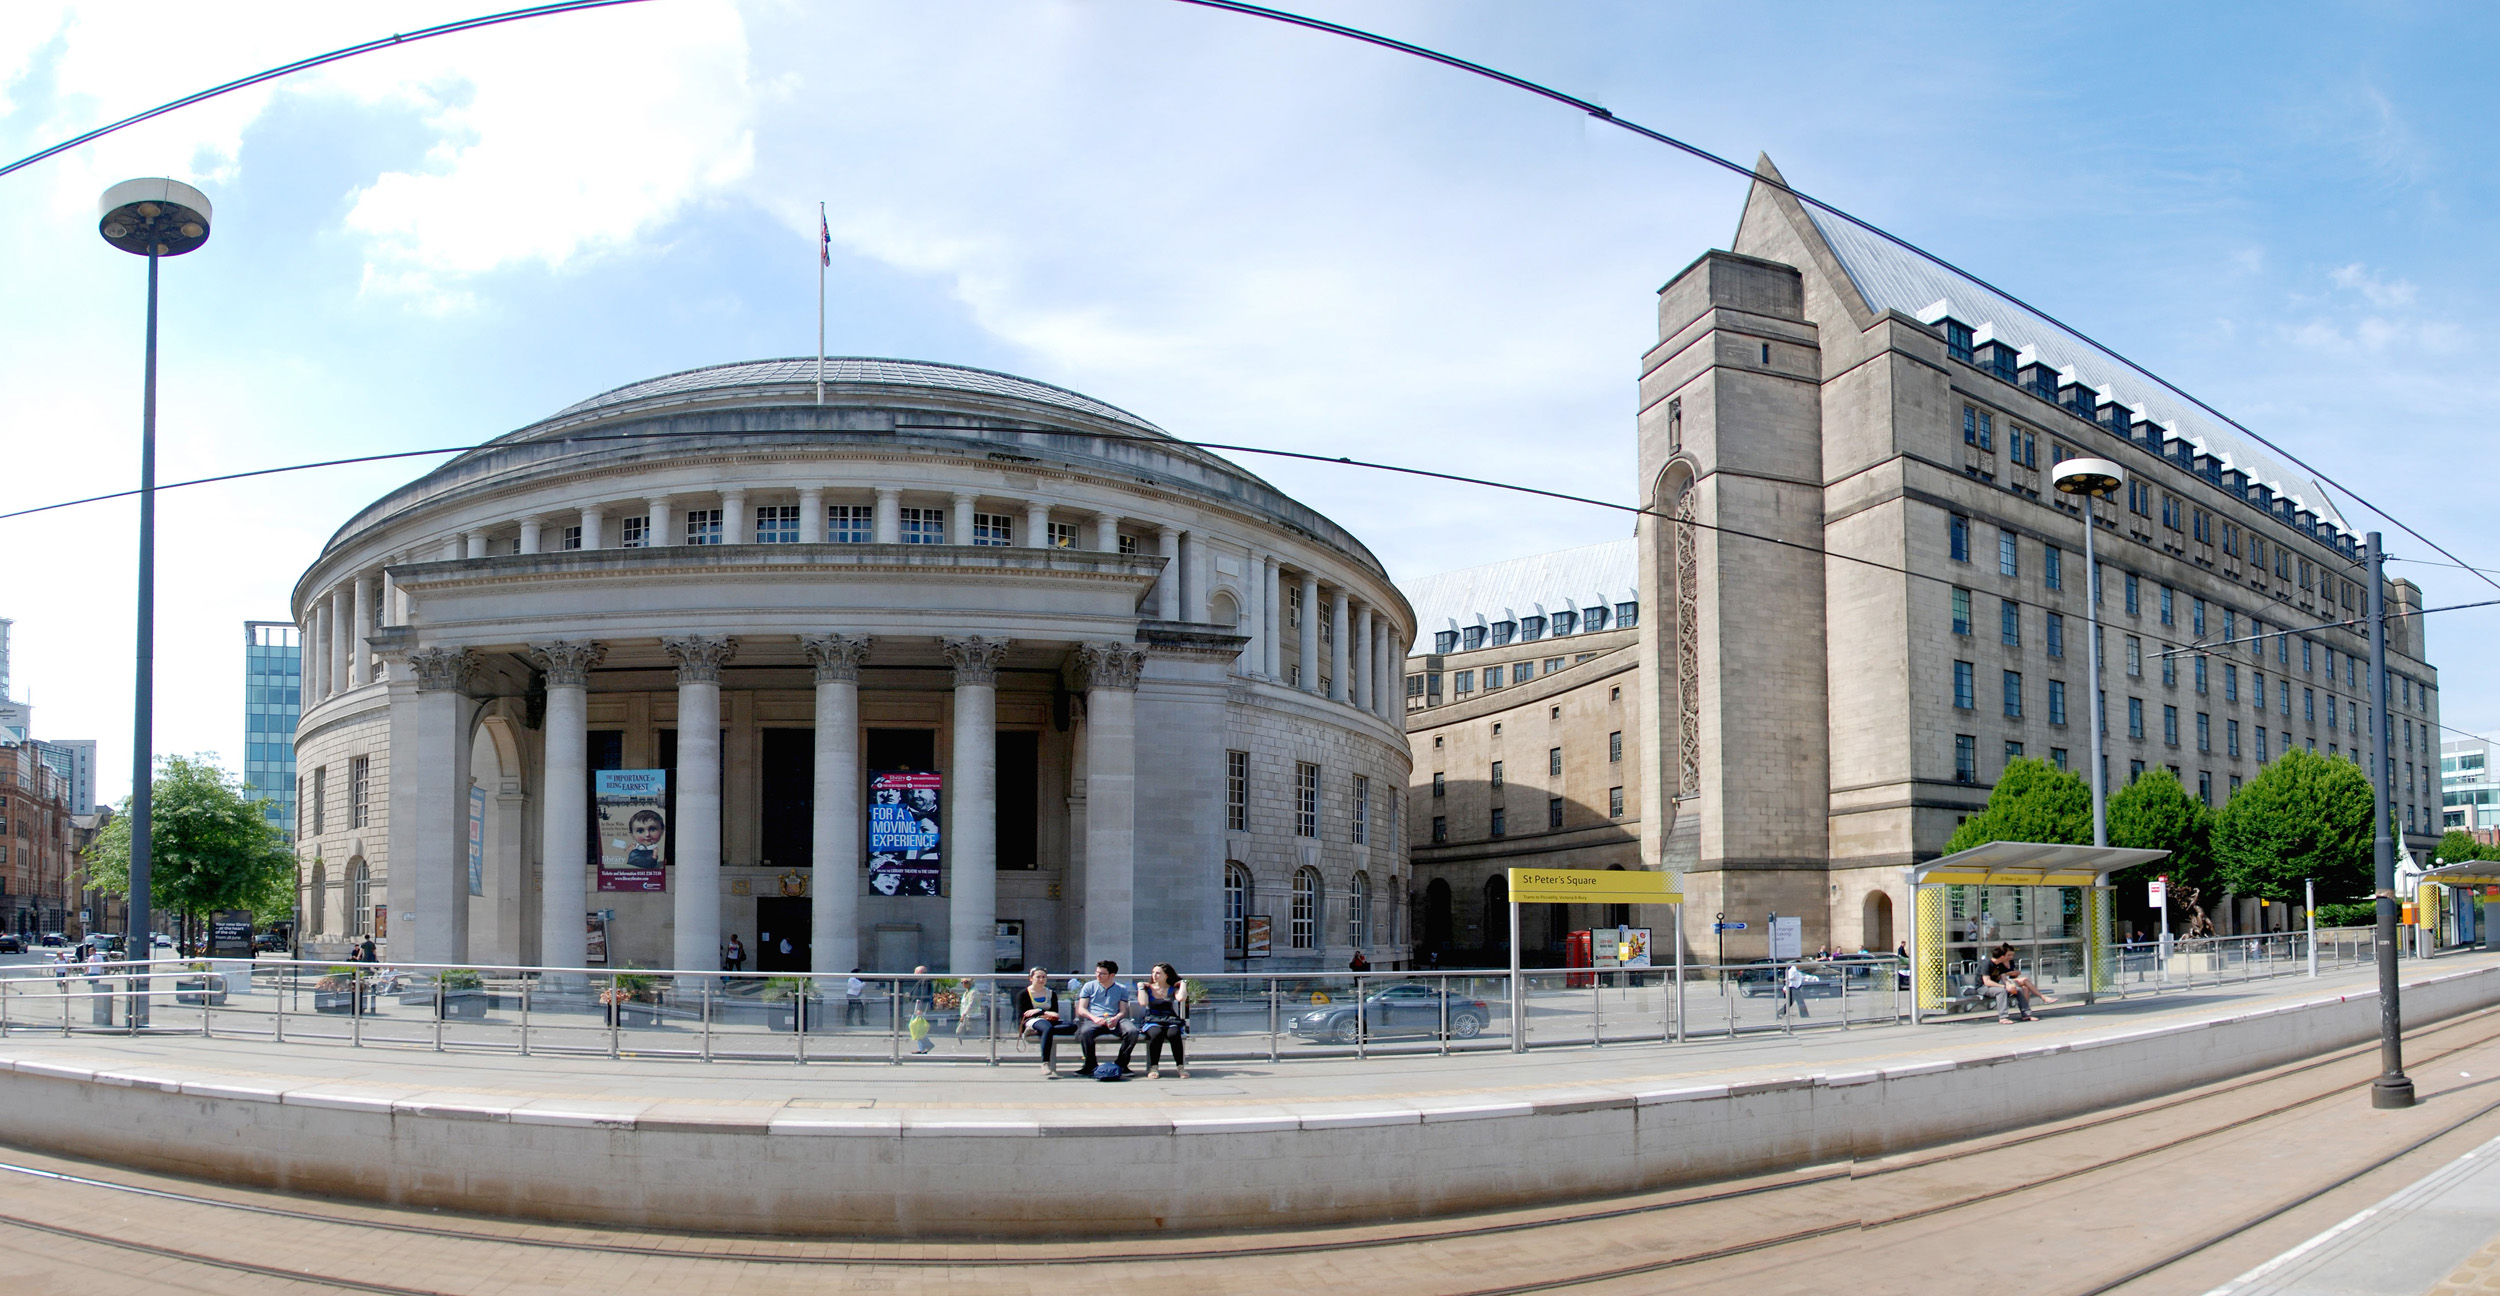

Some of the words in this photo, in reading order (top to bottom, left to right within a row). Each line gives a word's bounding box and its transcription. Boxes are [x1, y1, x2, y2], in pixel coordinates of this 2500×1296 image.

[872, 808, 893, 820] FOR
[896, 808, 904, 820] A
[872, 820, 916, 834] MOVING
[872, 834, 936, 847] EXPERIENCE
[1523, 874, 1532, 883] St
[1534, 875, 1565, 884] Peter's
[1567, 876, 1597, 886] Square
